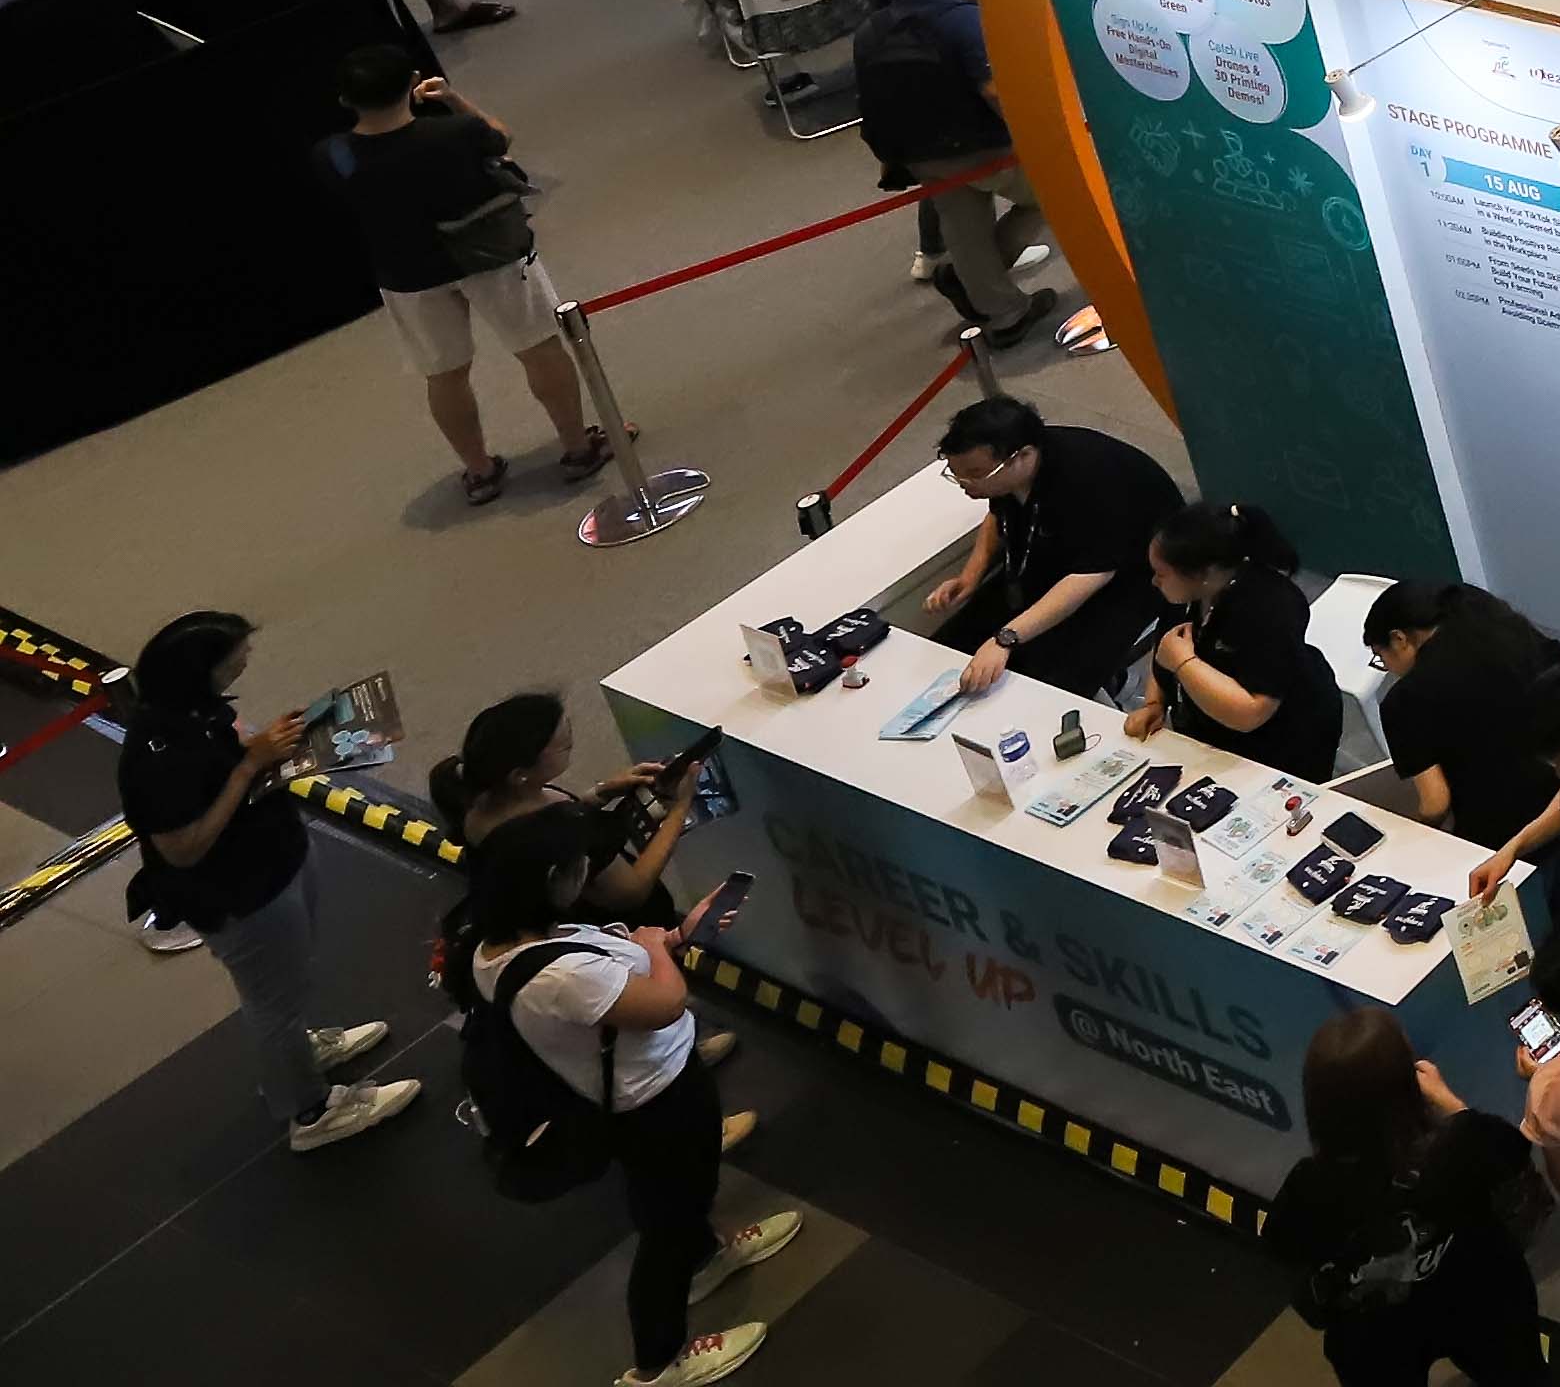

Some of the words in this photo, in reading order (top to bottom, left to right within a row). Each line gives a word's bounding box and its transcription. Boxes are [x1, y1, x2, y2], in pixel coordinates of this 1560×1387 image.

[1388, 103, 1441, 131] STAGE
[1444, 118, 1552, 159] PROGRAMME
[1484, 174, 1504, 191] 15
[1505, 179, 1541, 201] AUG
[1069, 1009, 1102, 1044] @
[1109, 1020, 1196, 1080] North
[1202, 1063, 1276, 1116] East
